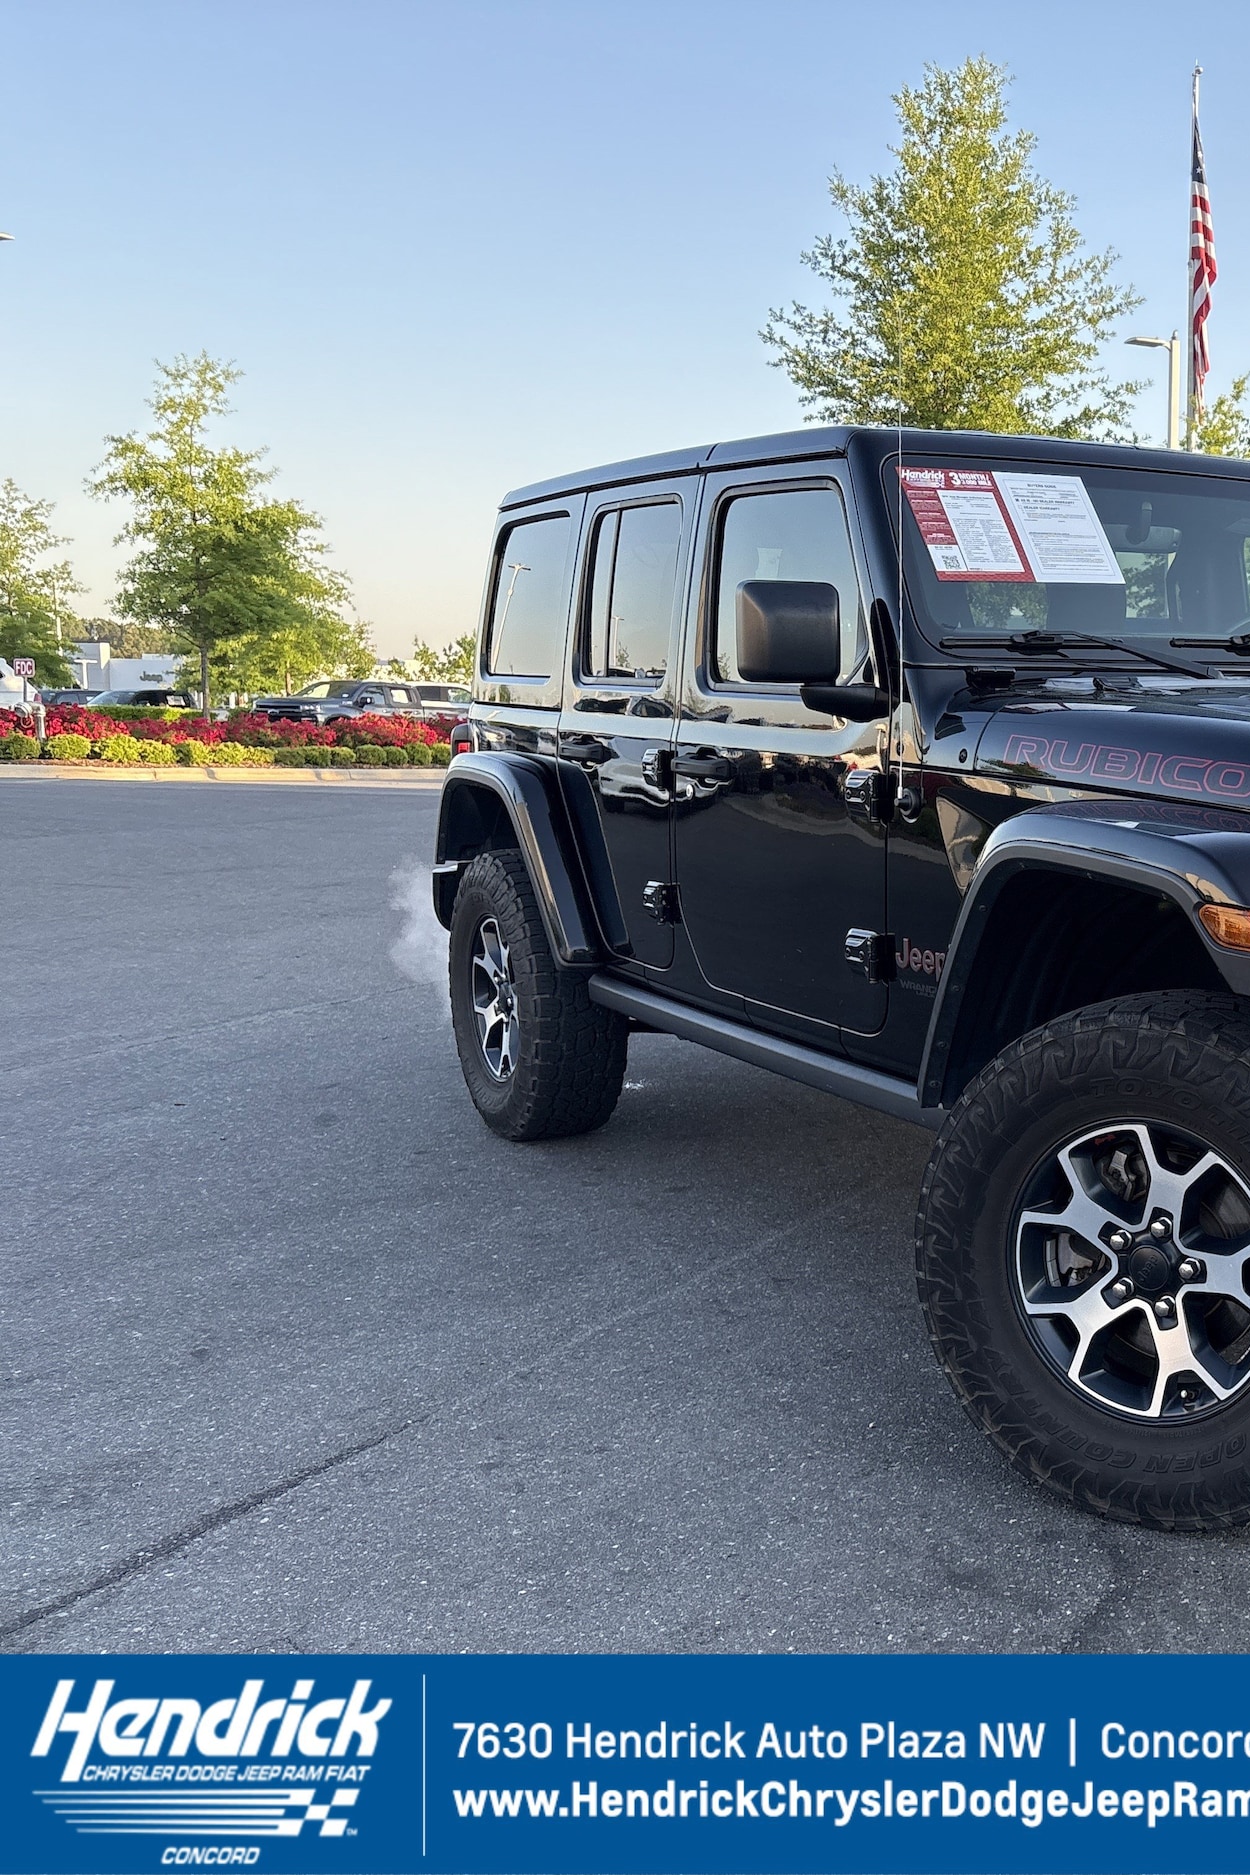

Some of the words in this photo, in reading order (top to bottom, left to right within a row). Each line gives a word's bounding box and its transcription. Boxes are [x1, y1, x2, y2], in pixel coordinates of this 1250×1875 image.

[901, 469, 945, 481] Hendrick
[949, 472, 961, 486] 3
[15, 660, 33, 675] FDC
[140, 670, 163, 684] Jeep
[895, 937, 946, 983] Jeep
[899, 978, 938, 994] WRANG
[1091, 1077, 1202, 1110] TOYO
[1137, 1255, 1158, 1283] Jeep
[984, 1346, 1137, 1468] COUNTRY
[1143, 1431, 1247, 1473] OPEN
